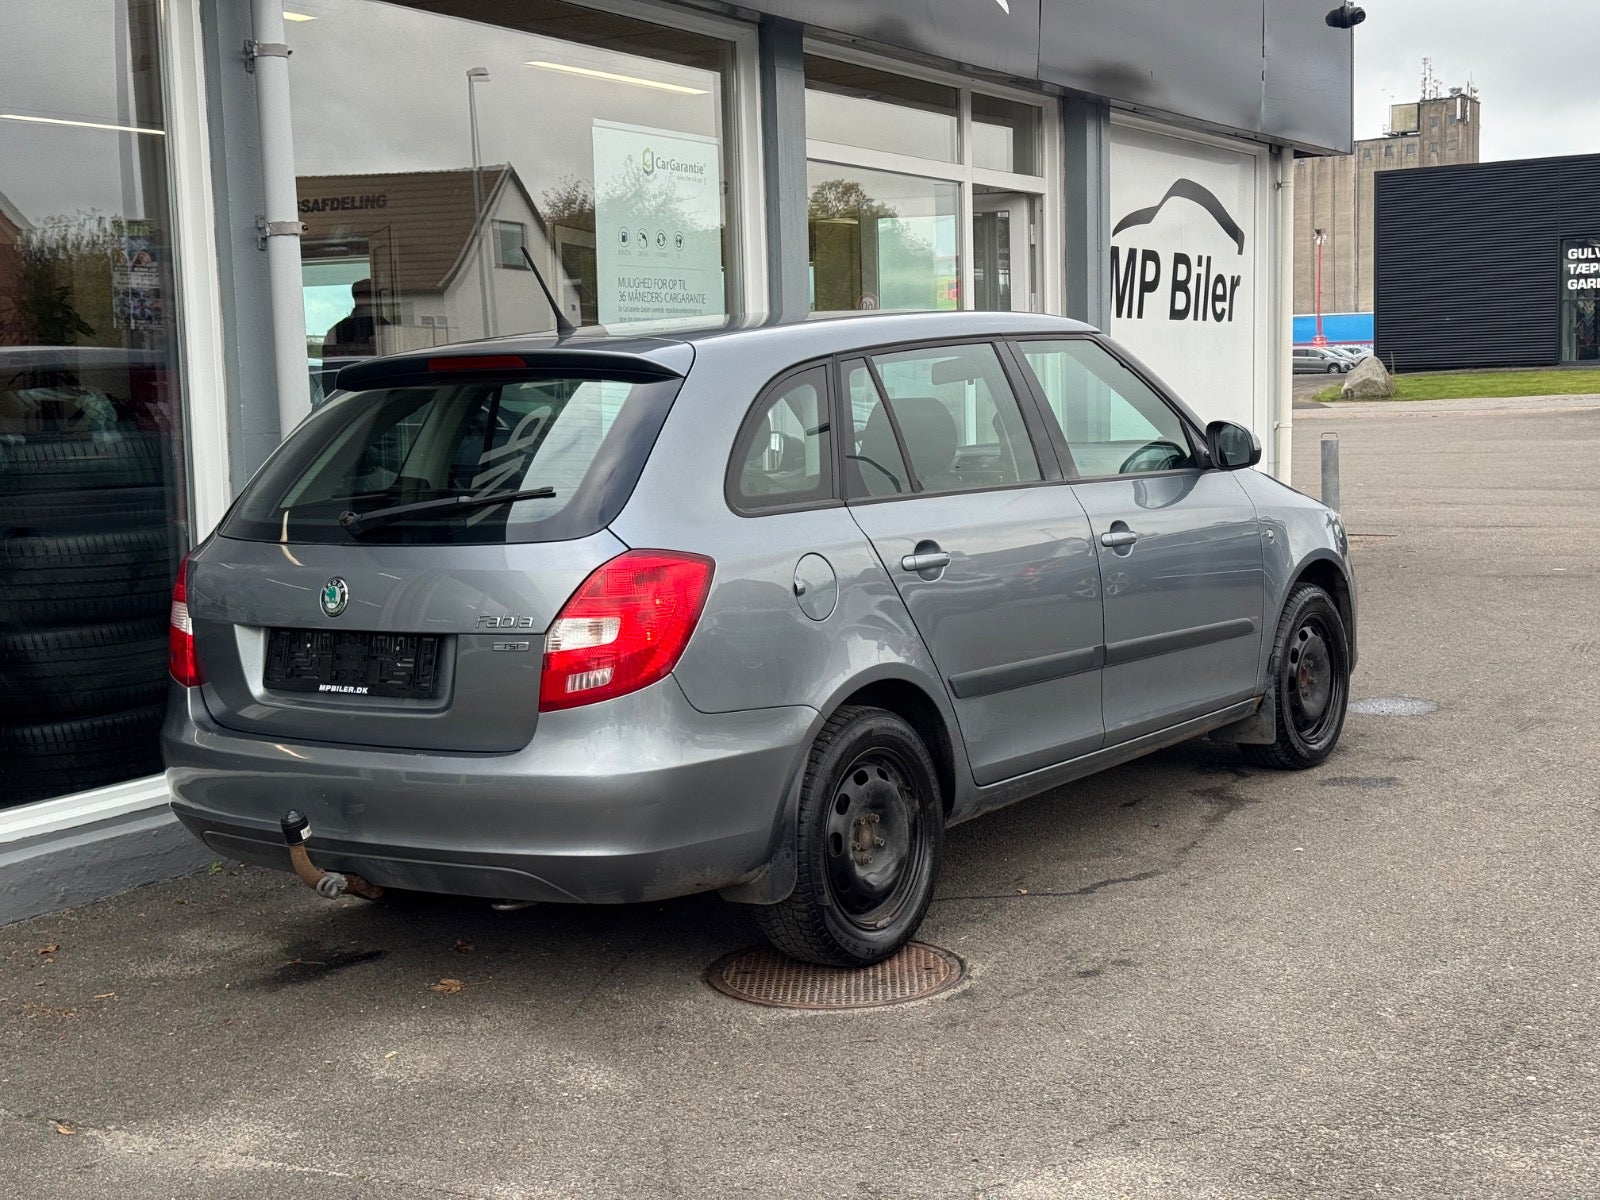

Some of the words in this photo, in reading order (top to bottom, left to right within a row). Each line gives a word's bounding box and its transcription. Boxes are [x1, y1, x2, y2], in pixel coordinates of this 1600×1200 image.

[655, 156, 704, 175] CarGarantie
[1567, 262, 1600, 275] TÆP
[653, 278, 668, 290] FOR
[668, 279, 678, 291] OP
[678, 279, 688, 291] TIL
[1110, 246, 1161, 319] MP
[1169, 252, 1242, 323] Biler
[618, 290, 627, 303] 36
[627, 288, 664, 304] MÅNEDERS
[475, 613, 533, 629] Fabia
[318, 684, 369, 695] MPBILER.DK
